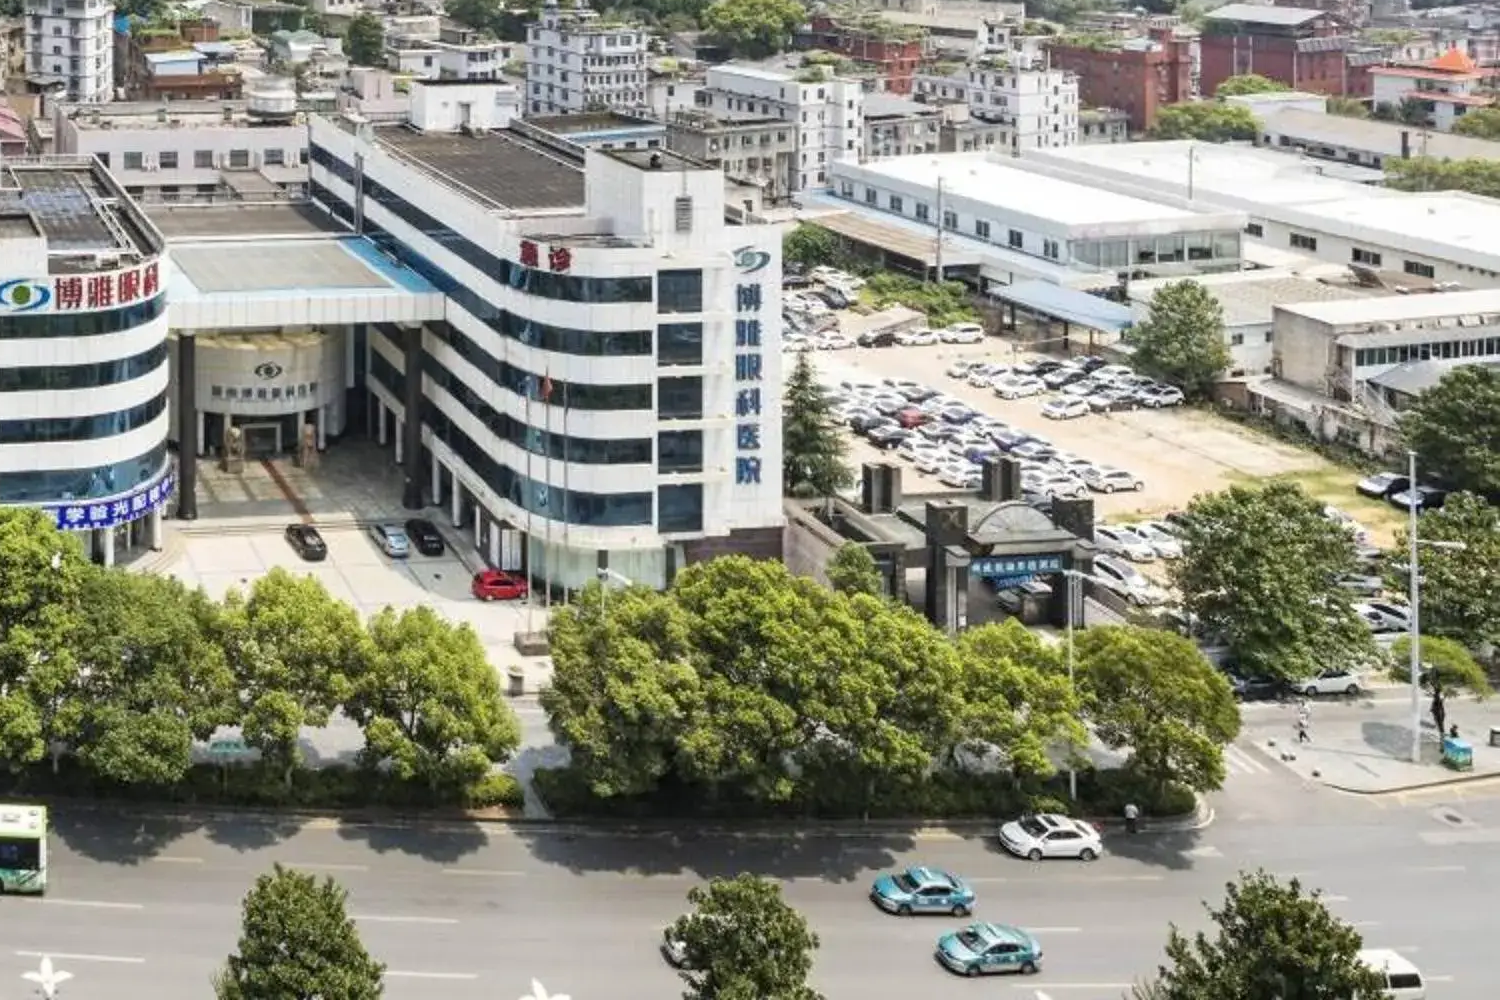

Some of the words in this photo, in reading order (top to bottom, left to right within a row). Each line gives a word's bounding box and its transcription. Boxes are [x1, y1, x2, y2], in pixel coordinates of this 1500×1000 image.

[55, 262, 158, 310] 博雅眼科
[735, 284, 762, 484] 博雅眼科医院
